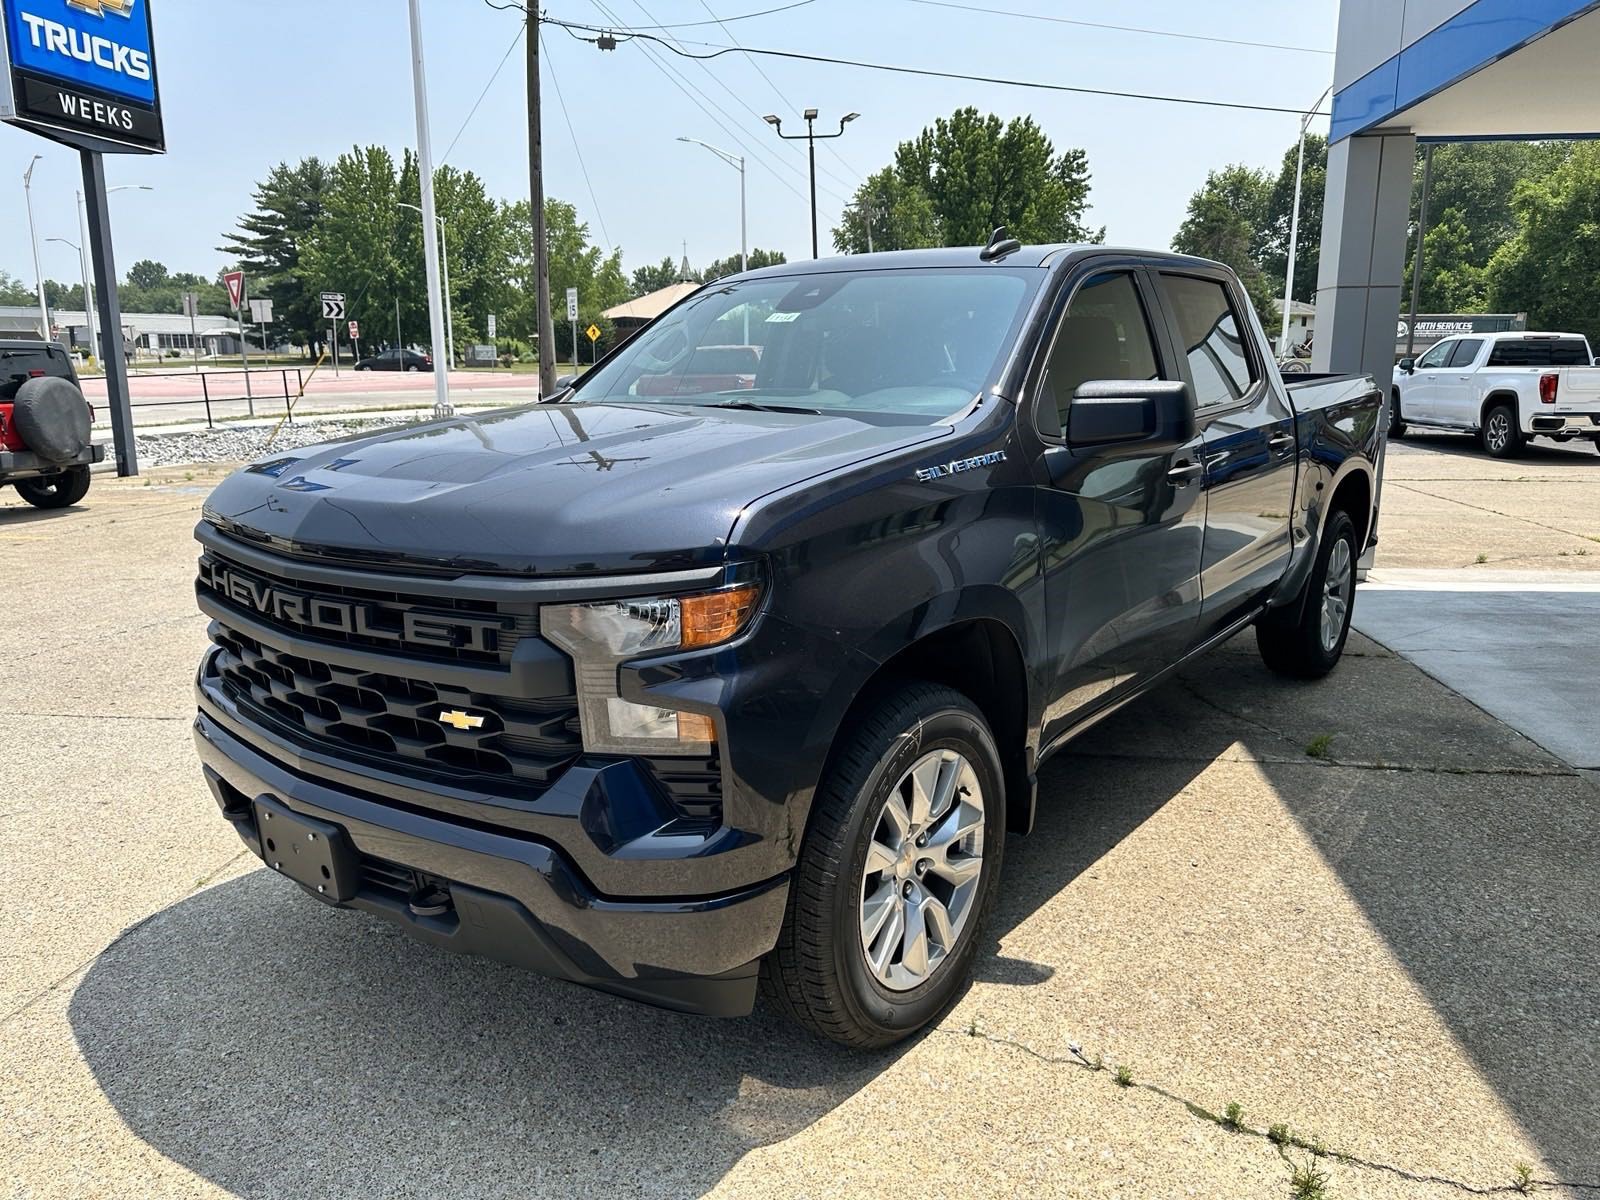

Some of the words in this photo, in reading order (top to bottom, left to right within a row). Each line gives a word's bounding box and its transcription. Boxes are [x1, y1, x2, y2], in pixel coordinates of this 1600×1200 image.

[21, 12, 151, 81] TRUCKS
[58, 92, 134, 130] WEEKS
[1414, 321, 1437, 330] ARTH
[1436, 321, 1473, 330] SERVICES
[915, 450, 1008, 482] SILVERADO
[198, 556, 502, 652] CHEVROLET
